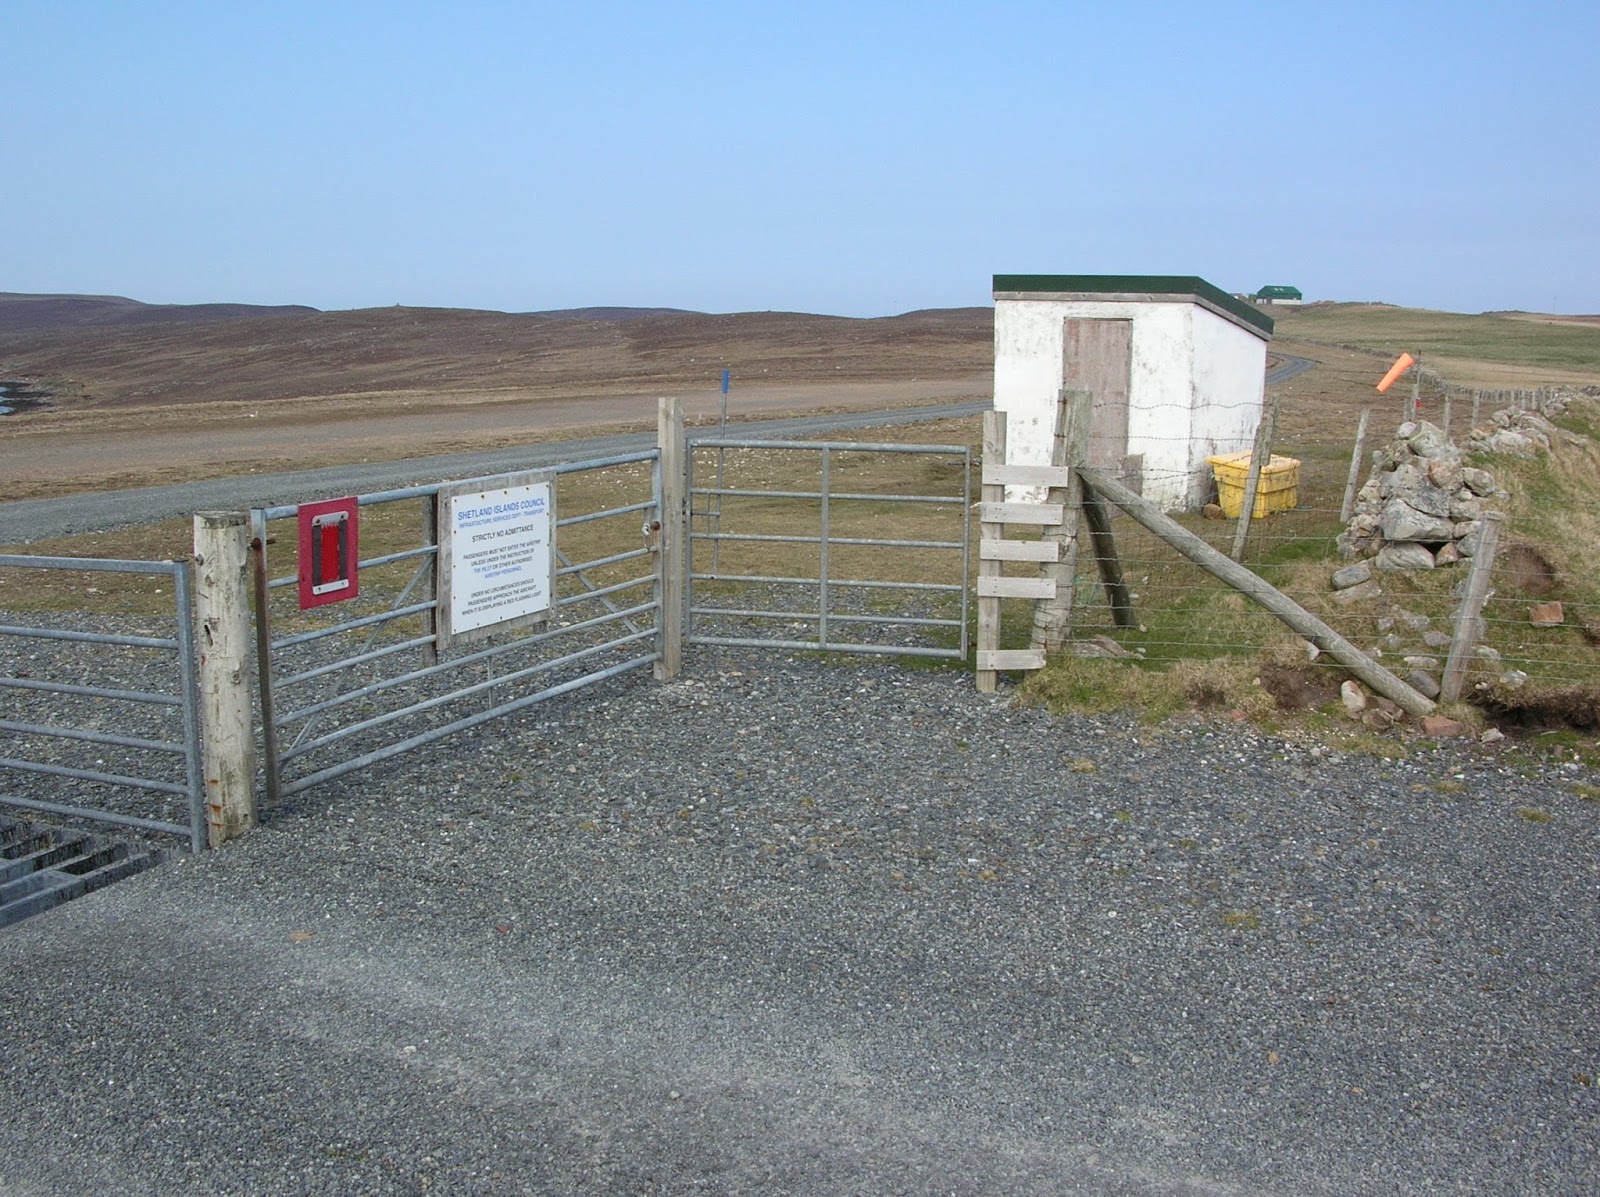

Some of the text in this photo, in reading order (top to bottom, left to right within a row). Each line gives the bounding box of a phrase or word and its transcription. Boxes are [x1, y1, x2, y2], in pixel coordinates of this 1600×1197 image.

[458, 498, 545, 520] SHETLAND ISLANDS COUNCIL
[472, 533, 495, 542] STRICTLY
[505, 524, 534, 536] ADMITTANCE
[463, 550, 488, 560] PASSENGERS
[508, 550, 529, 558] INSTRUCTION
[494, 592, 512, 600] APPROACH
